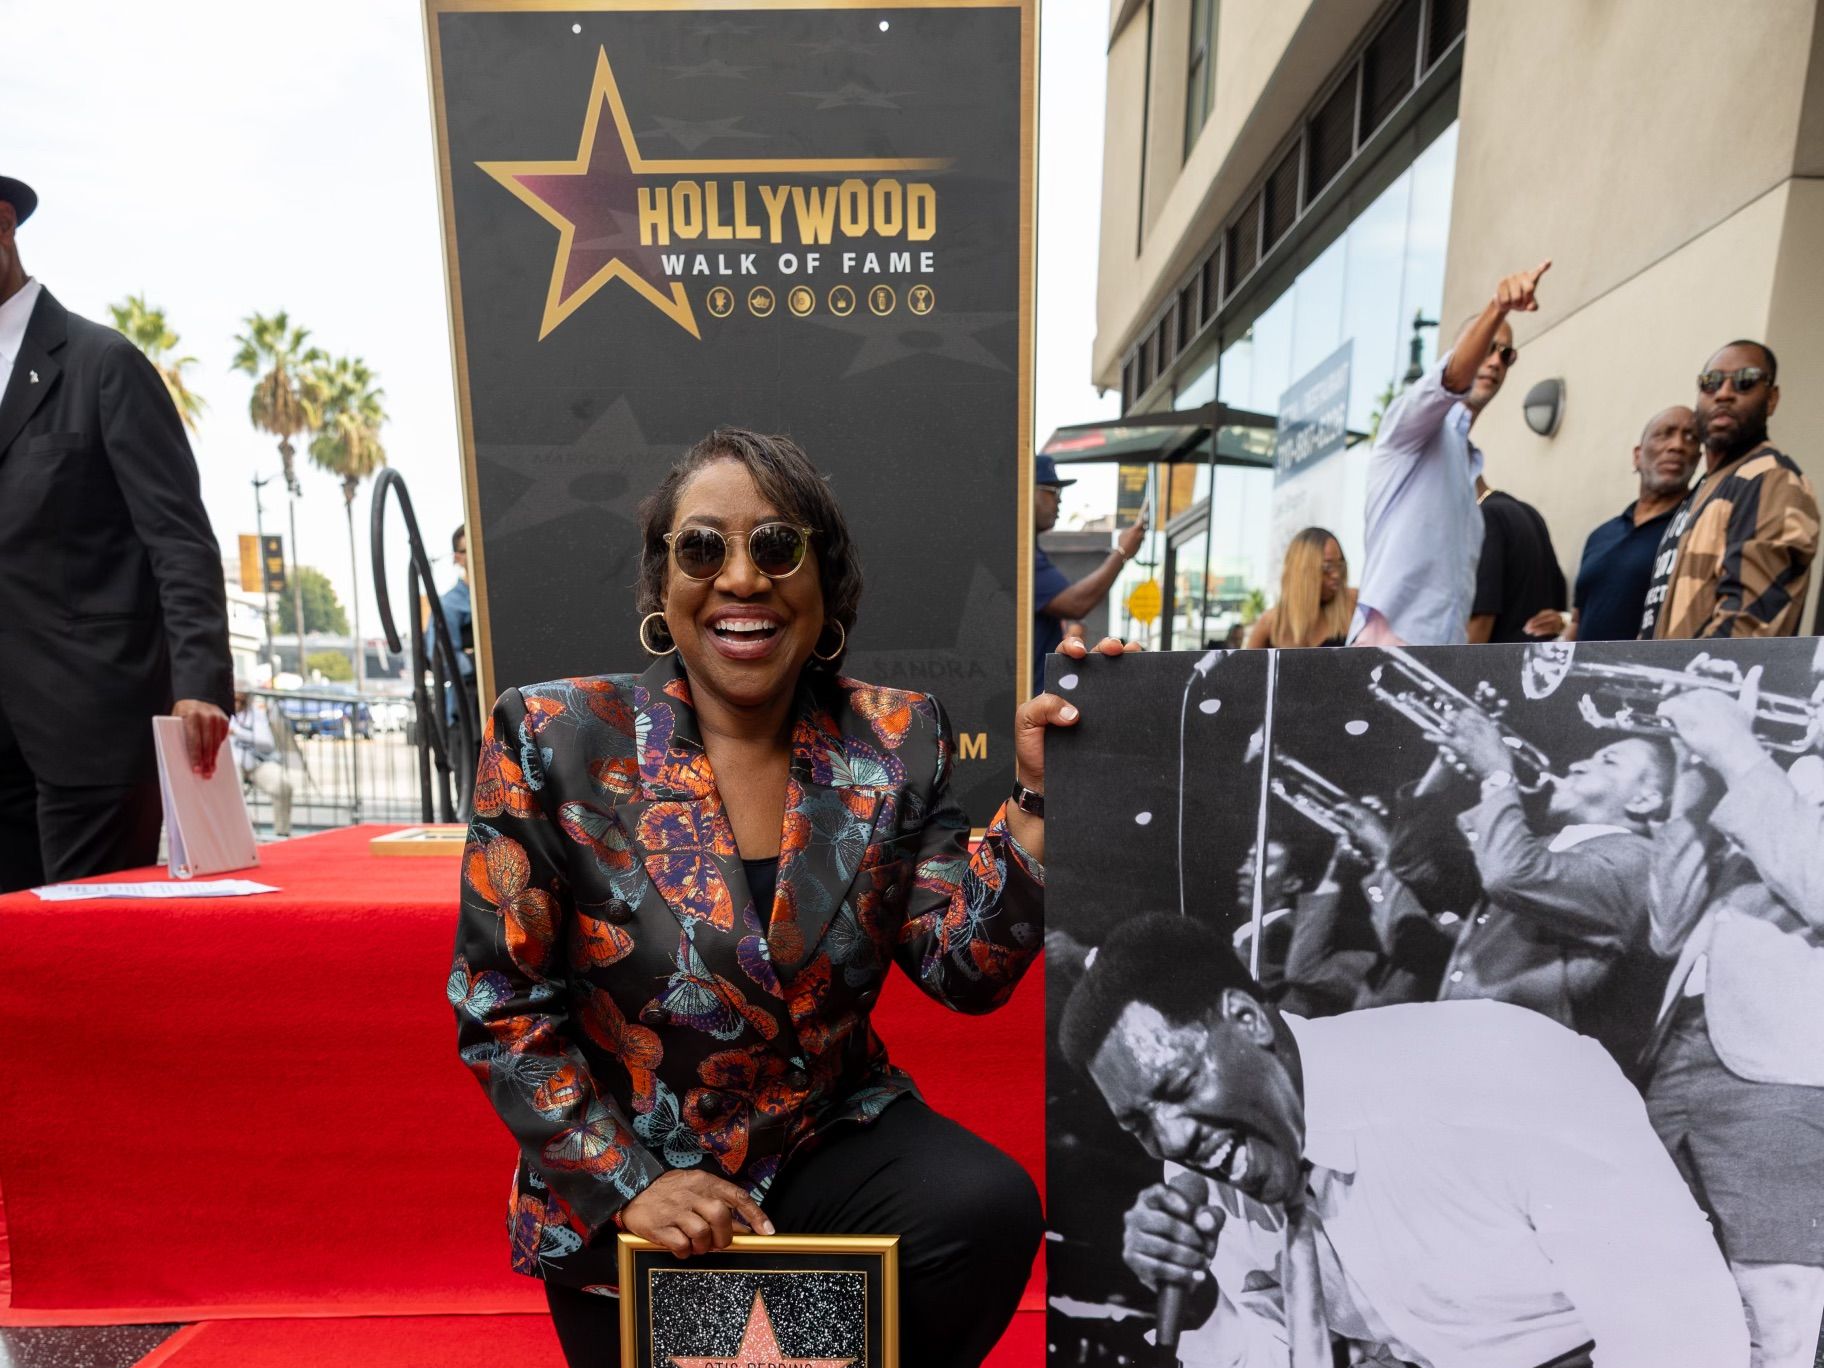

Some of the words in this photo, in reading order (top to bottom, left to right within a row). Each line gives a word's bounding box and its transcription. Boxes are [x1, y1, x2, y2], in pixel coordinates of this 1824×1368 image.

[637, 178, 937, 246] HOLLYWOOD
[661, 253, 758, 276] WALK
[778, 252, 821, 275] OF
[842, 251, 935, 275] FAME
